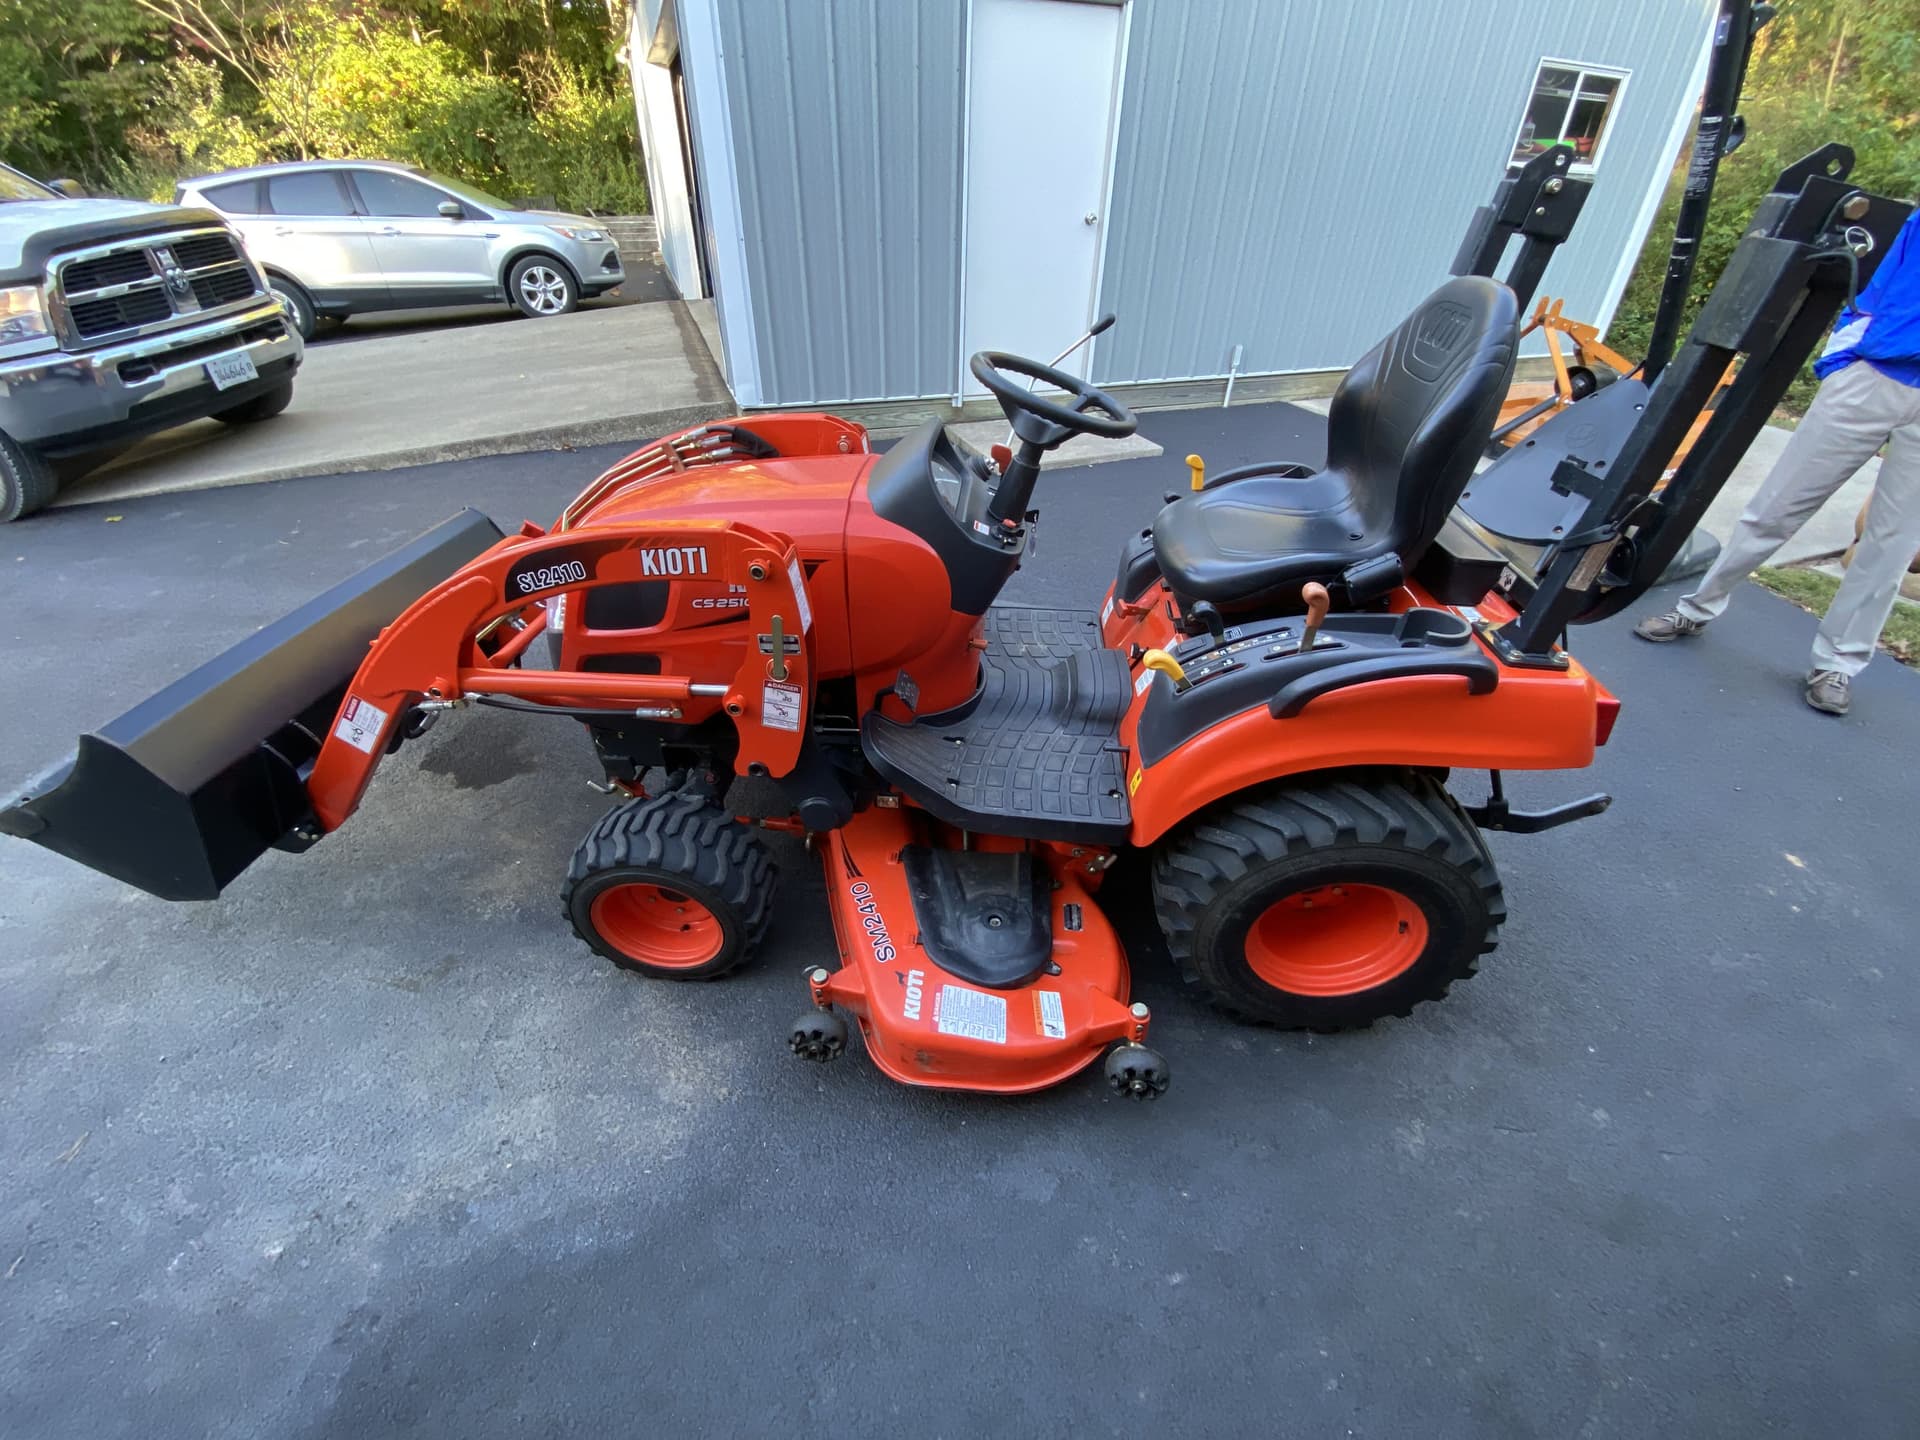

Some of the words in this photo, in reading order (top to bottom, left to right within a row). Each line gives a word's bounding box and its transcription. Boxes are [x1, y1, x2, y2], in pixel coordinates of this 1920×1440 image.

[517, 561, 586, 593] SL2410
[640, 547, 708, 576] KIOTI
[851, 882, 896, 963] SM2410
[903, 969, 925, 1021] KIOTI
